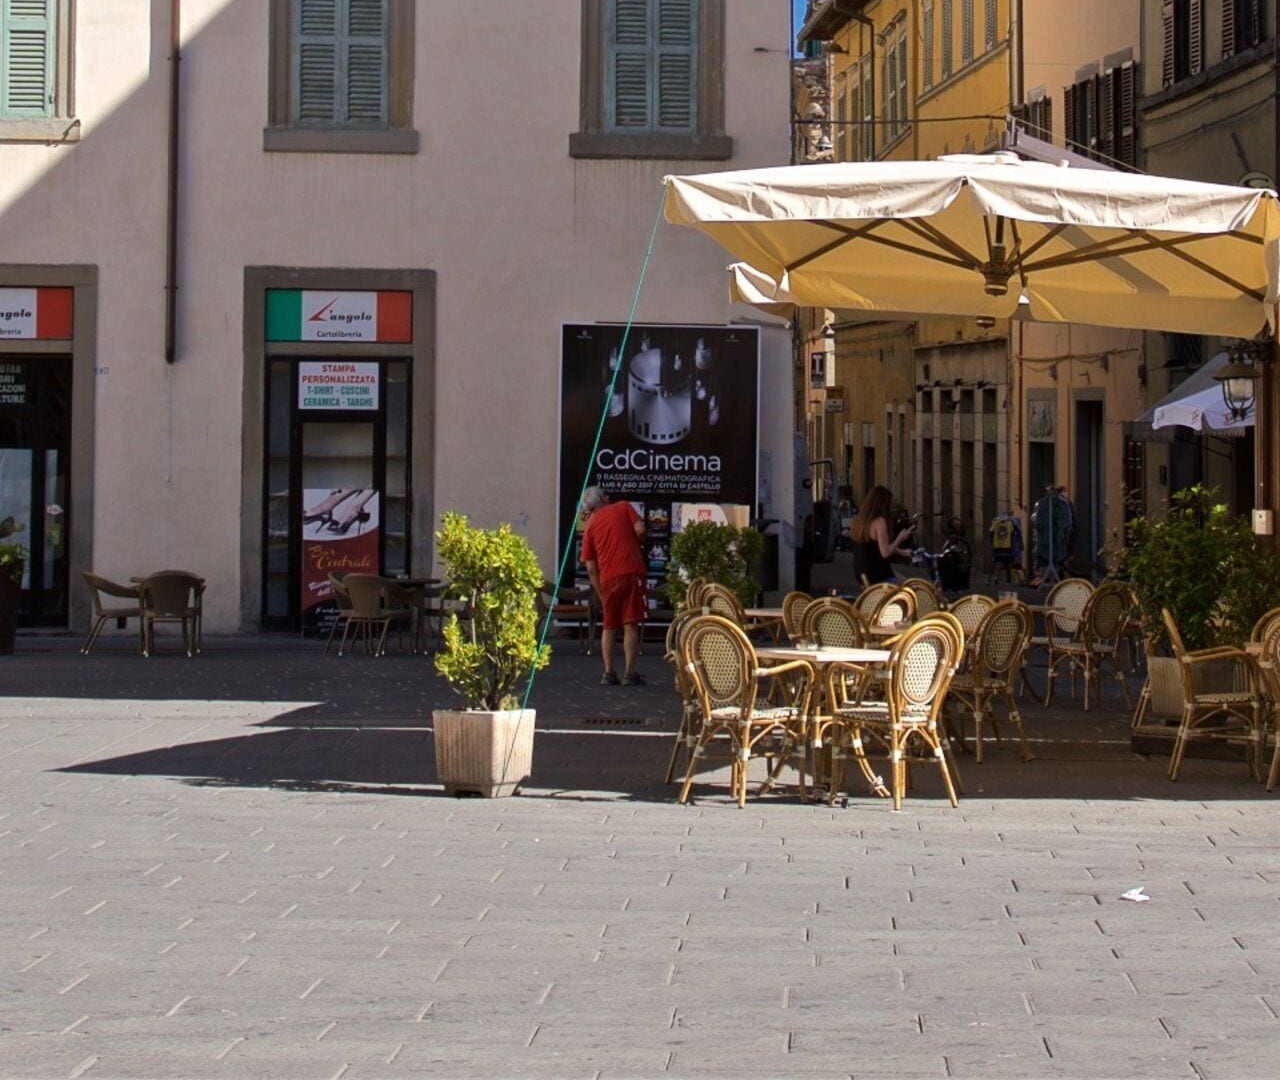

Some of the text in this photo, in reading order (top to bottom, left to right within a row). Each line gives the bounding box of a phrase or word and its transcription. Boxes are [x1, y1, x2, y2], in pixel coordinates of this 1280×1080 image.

[316, 330, 362, 338] Cartolibreria
[322, 364, 356, 373] STAMPA
[302, 375, 376, 384] PERSONALIZZATA
[307, 386, 334, 395] T-SHIRT
[340, 386, 370, 395] CUSCINI
[303, 397, 340, 407] CERAMICA
[347, 397, 374, 407] TARGHE
[596, 448, 721, 471] CdCinema
[308, 545, 336, 558] Bar
